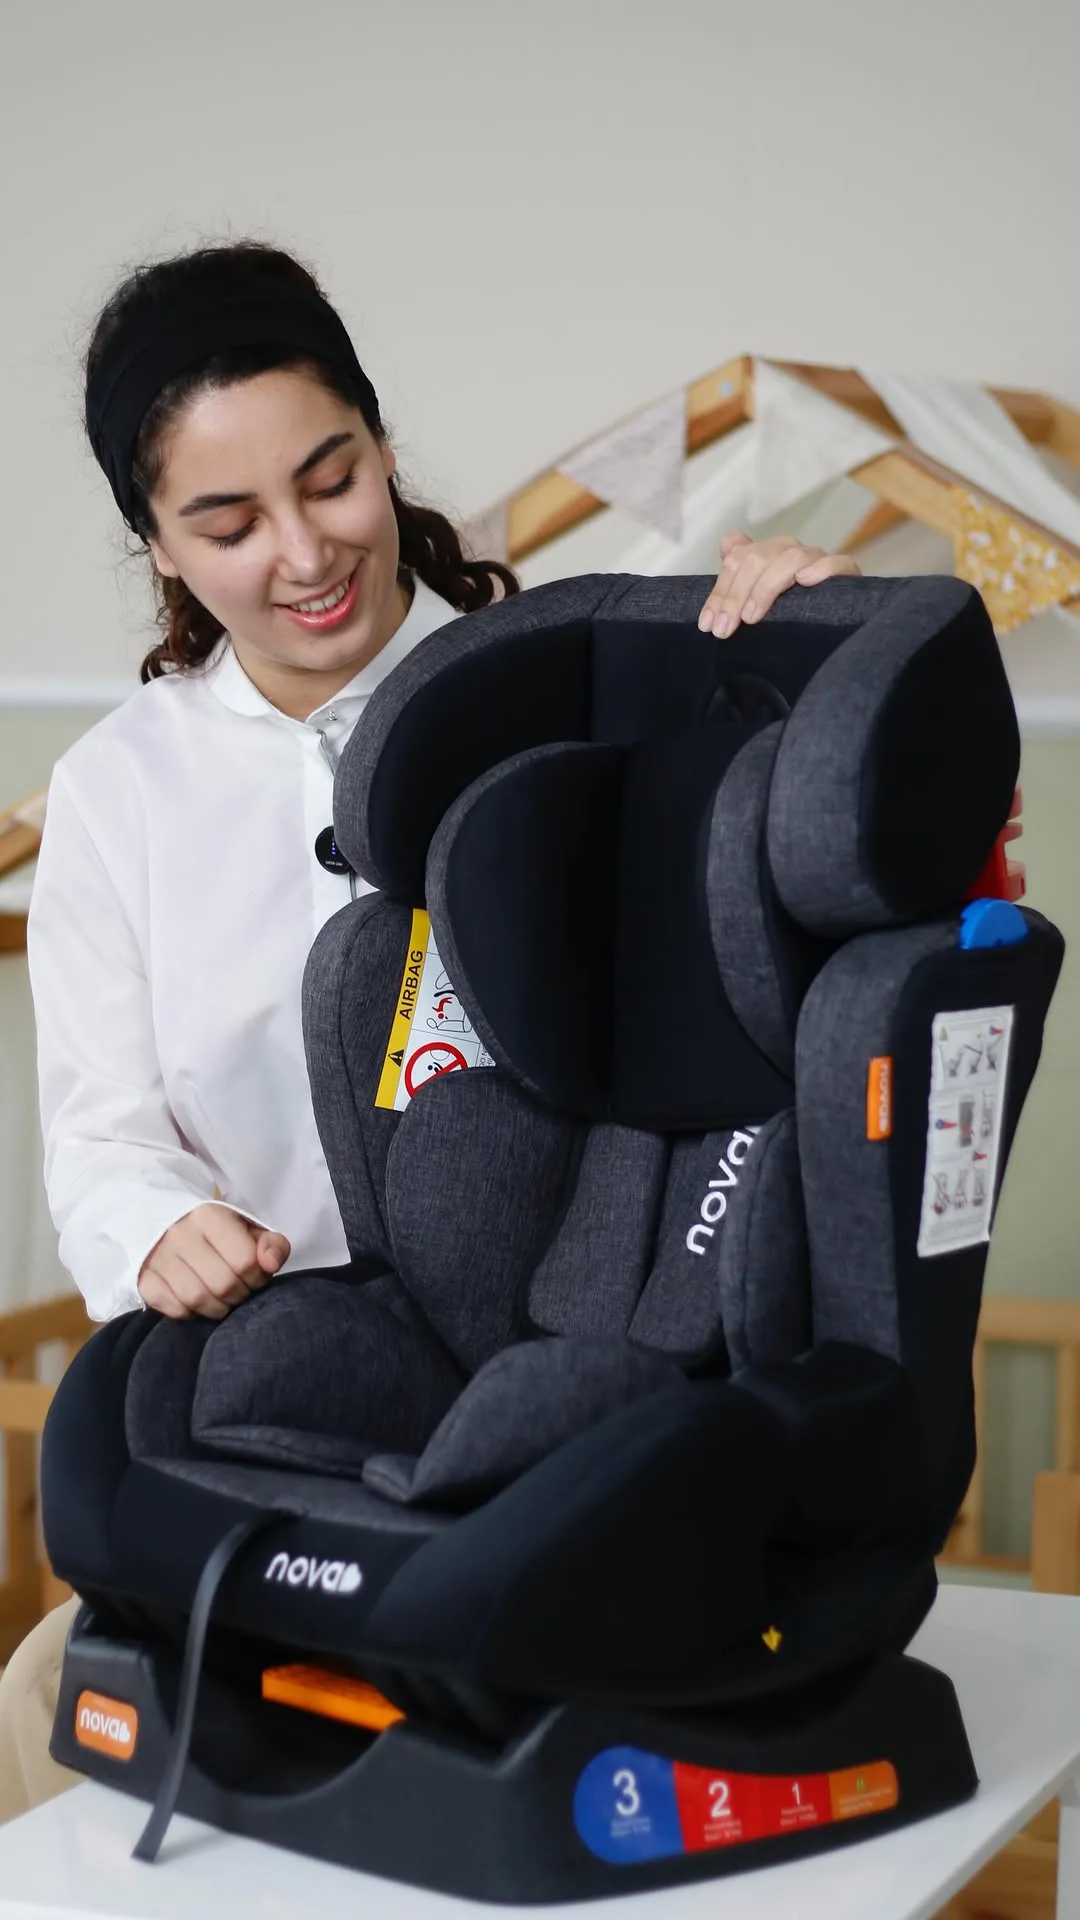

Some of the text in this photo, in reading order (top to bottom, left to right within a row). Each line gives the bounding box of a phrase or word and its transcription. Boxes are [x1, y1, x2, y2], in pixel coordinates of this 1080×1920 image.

[400, 950, 423, 1020] AIRBAG
[686, 1130, 754, 1256] nova
[264, 1551, 346, 1592] nova
[80, 1707, 120, 1740] nova
[613, 1769, 640, 1816] 3
[709, 1780, 730, 1818] 2
[792, 1782, 801, 1805] 1
